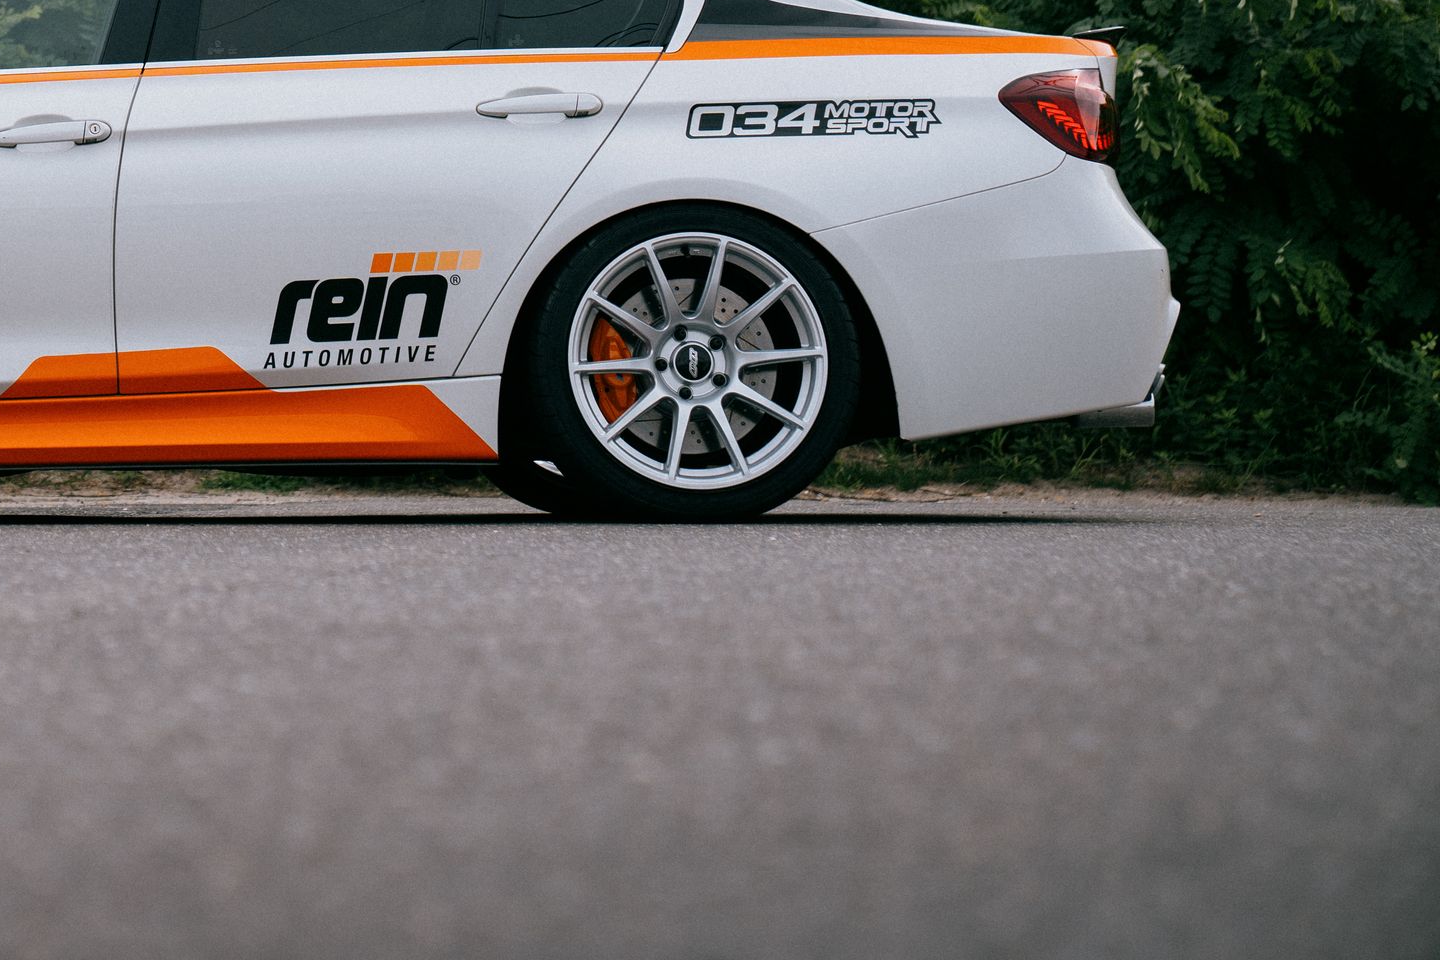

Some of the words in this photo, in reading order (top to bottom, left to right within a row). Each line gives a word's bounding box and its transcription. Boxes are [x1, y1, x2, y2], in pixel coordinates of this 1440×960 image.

[688, 103, 821, 137] 034
[823, 101, 938, 122] MOTOR
[825, 117, 929, 137] SPORT
[263, 344, 437, 370] AUTOMOTIVE
